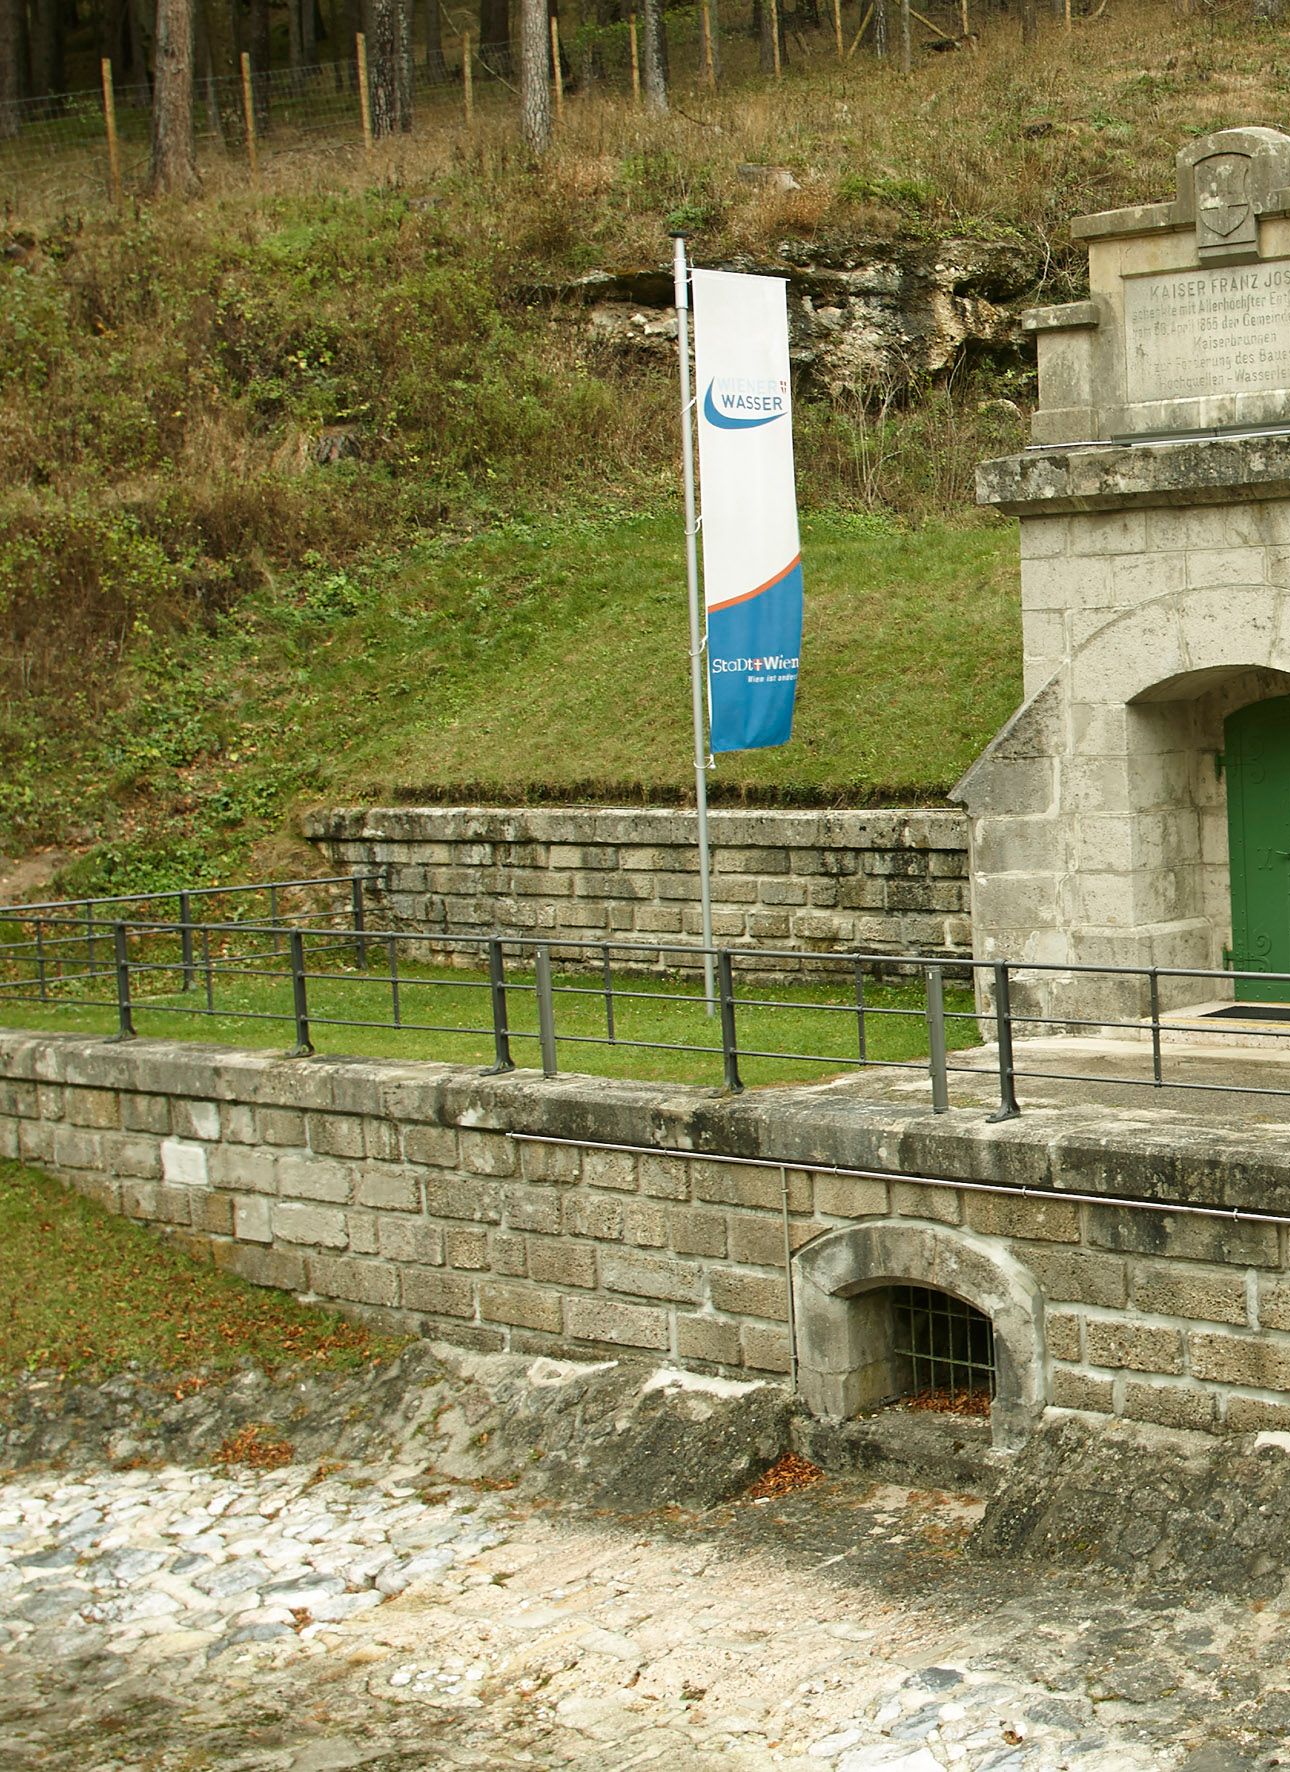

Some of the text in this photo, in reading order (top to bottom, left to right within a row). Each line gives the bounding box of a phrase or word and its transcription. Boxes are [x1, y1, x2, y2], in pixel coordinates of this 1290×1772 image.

[1150, 280, 1206, 300] KAISER
[1211, 273, 1258, 294] FRANZ
[1221, 314, 1240, 330] der
[1193, 332, 1277, 351] Kaiserbrunnen
[1235, 350, 1255, 365] des
[721, 394, 782, 411] WASSER
[763, 654, 799, 671] Wien
